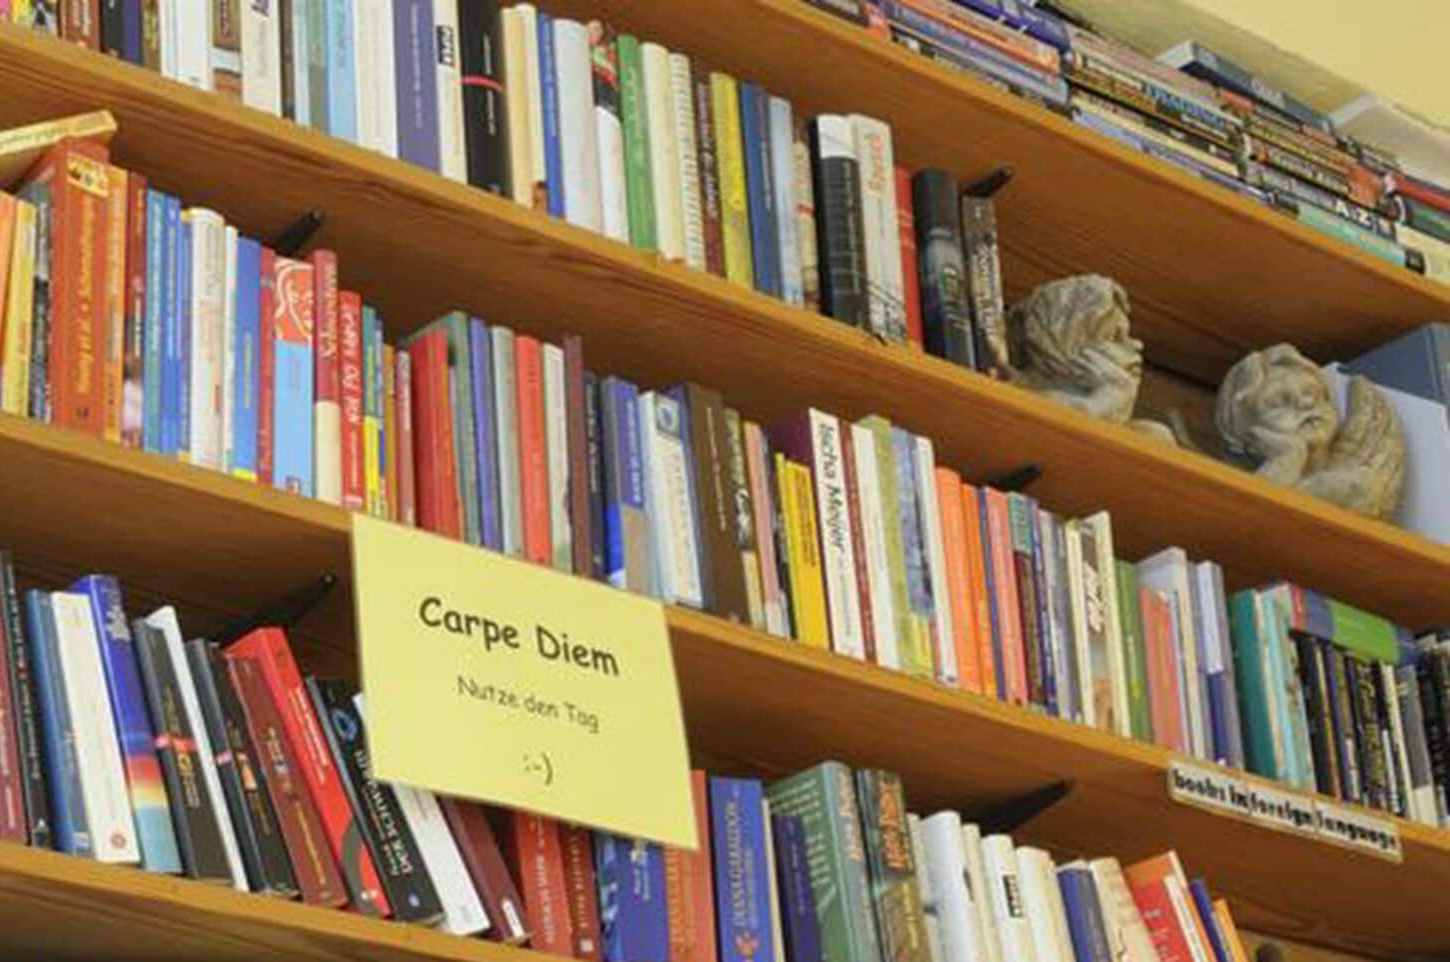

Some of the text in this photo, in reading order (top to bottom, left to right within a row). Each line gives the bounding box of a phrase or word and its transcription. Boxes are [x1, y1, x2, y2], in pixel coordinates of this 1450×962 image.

[820, 423, 845, 549] Ischa Meijer
[418, 597, 621, 678] Carpe Diem
[457, 675, 600, 734] Nutze den Tag
[1172, 767, 1226, 803] books
